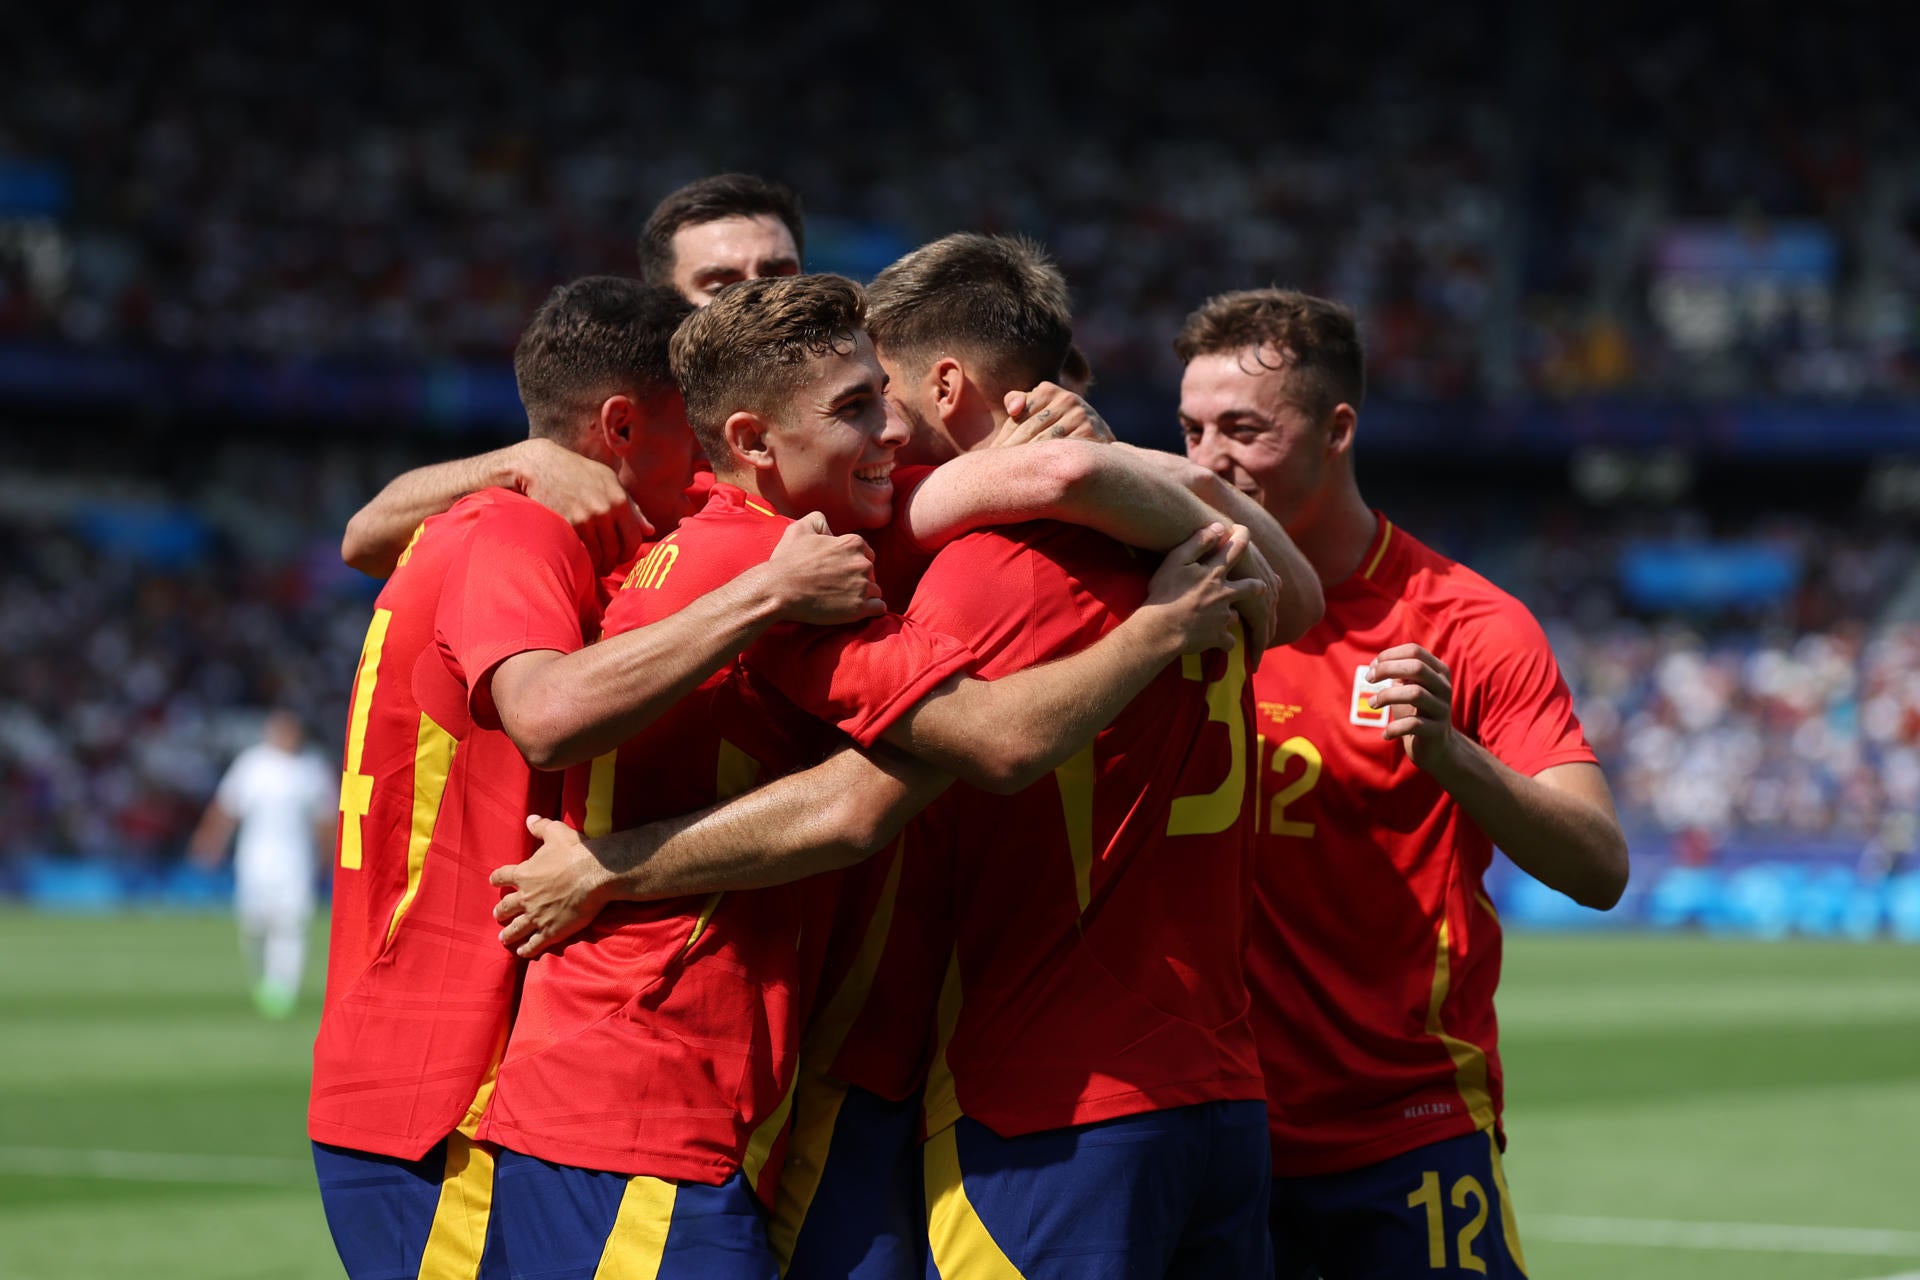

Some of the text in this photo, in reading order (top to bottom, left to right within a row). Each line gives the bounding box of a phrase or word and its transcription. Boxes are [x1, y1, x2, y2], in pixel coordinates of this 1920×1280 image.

[339, 607, 392, 870] 4
[1166, 618, 1247, 838] 3
[1407, 1171, 1488, 1276] 12
